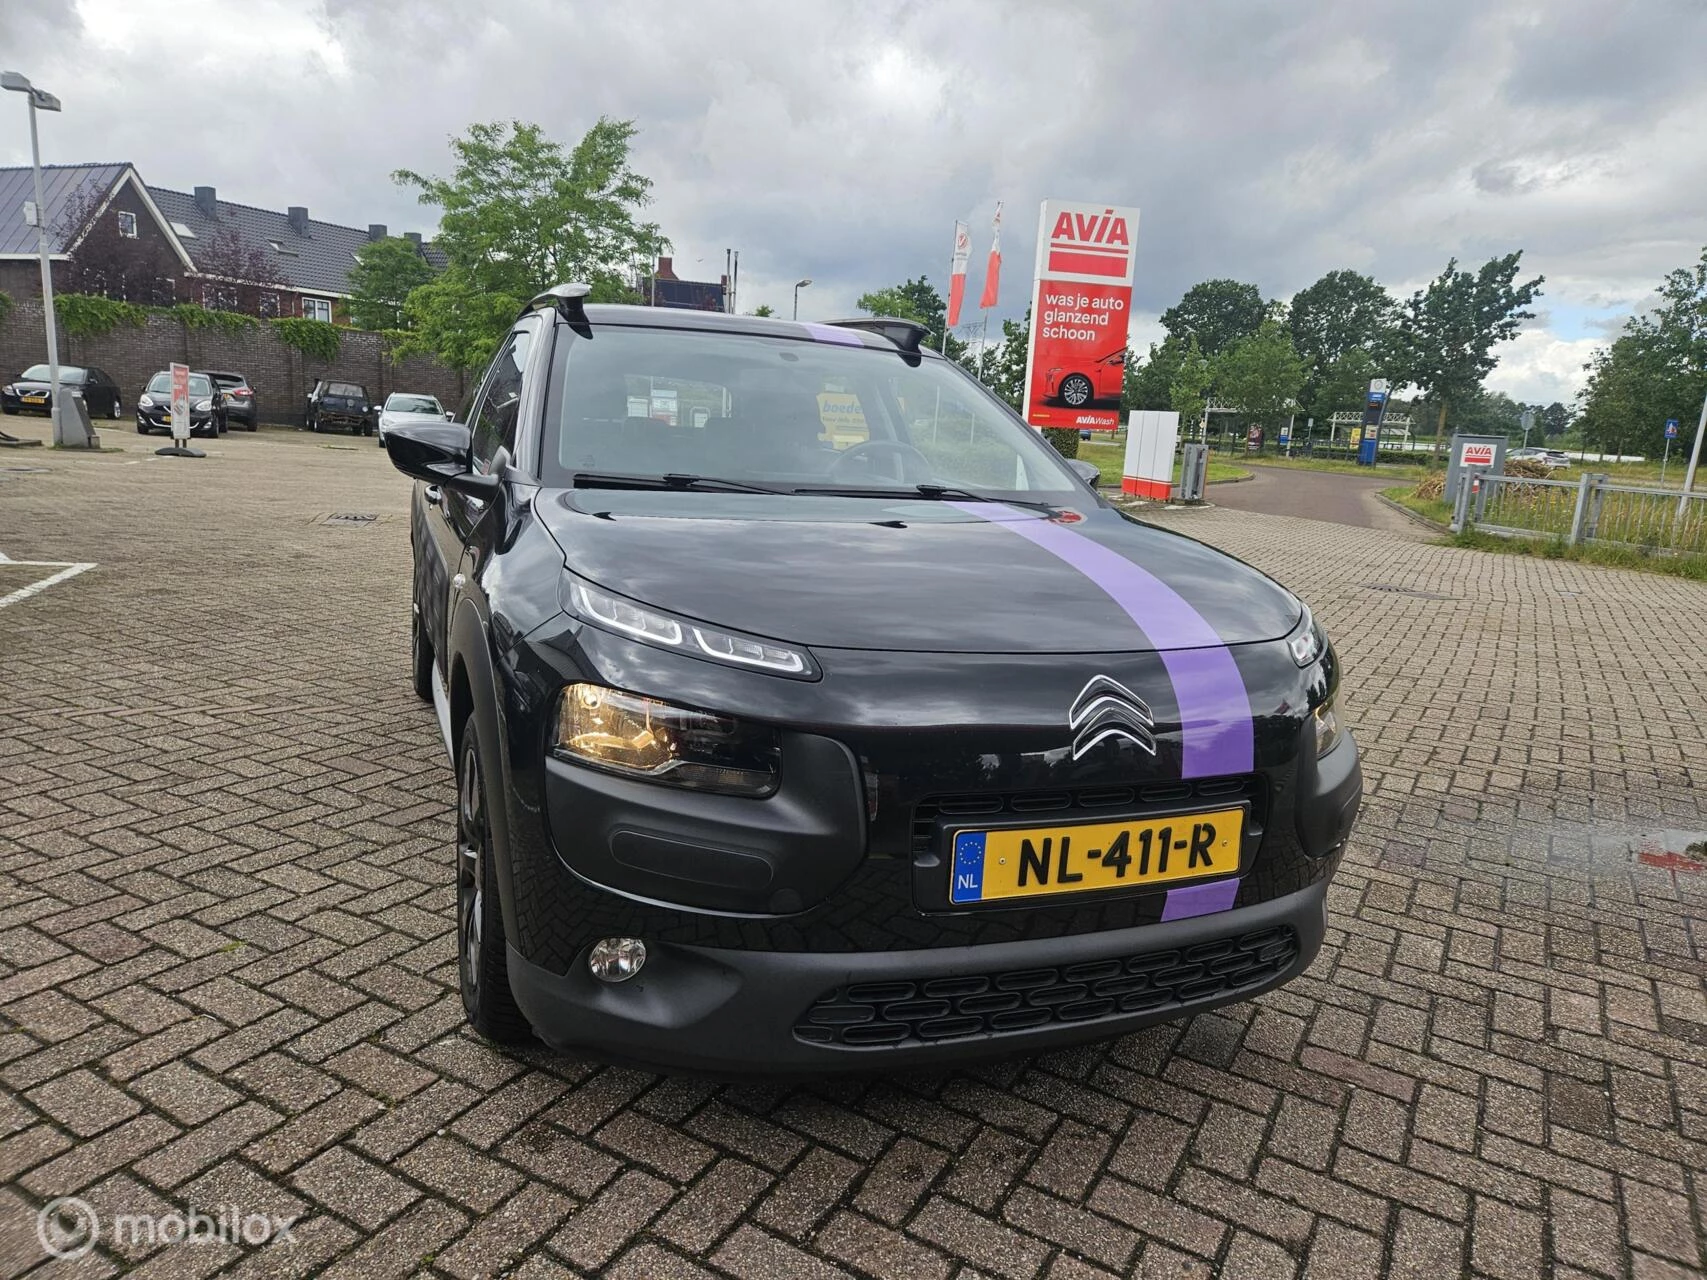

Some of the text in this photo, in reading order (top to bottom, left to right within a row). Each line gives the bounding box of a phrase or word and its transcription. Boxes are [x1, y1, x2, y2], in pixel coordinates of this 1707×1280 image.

[1046, 294, 1124, 311] was je auto
[1043, 309, 1109, 327] glanzend
[1042, 325, 1096, 341] schoon
[1017, 823, 1217, 887] NL-411-R
[958, 873, 979, 890] NL
